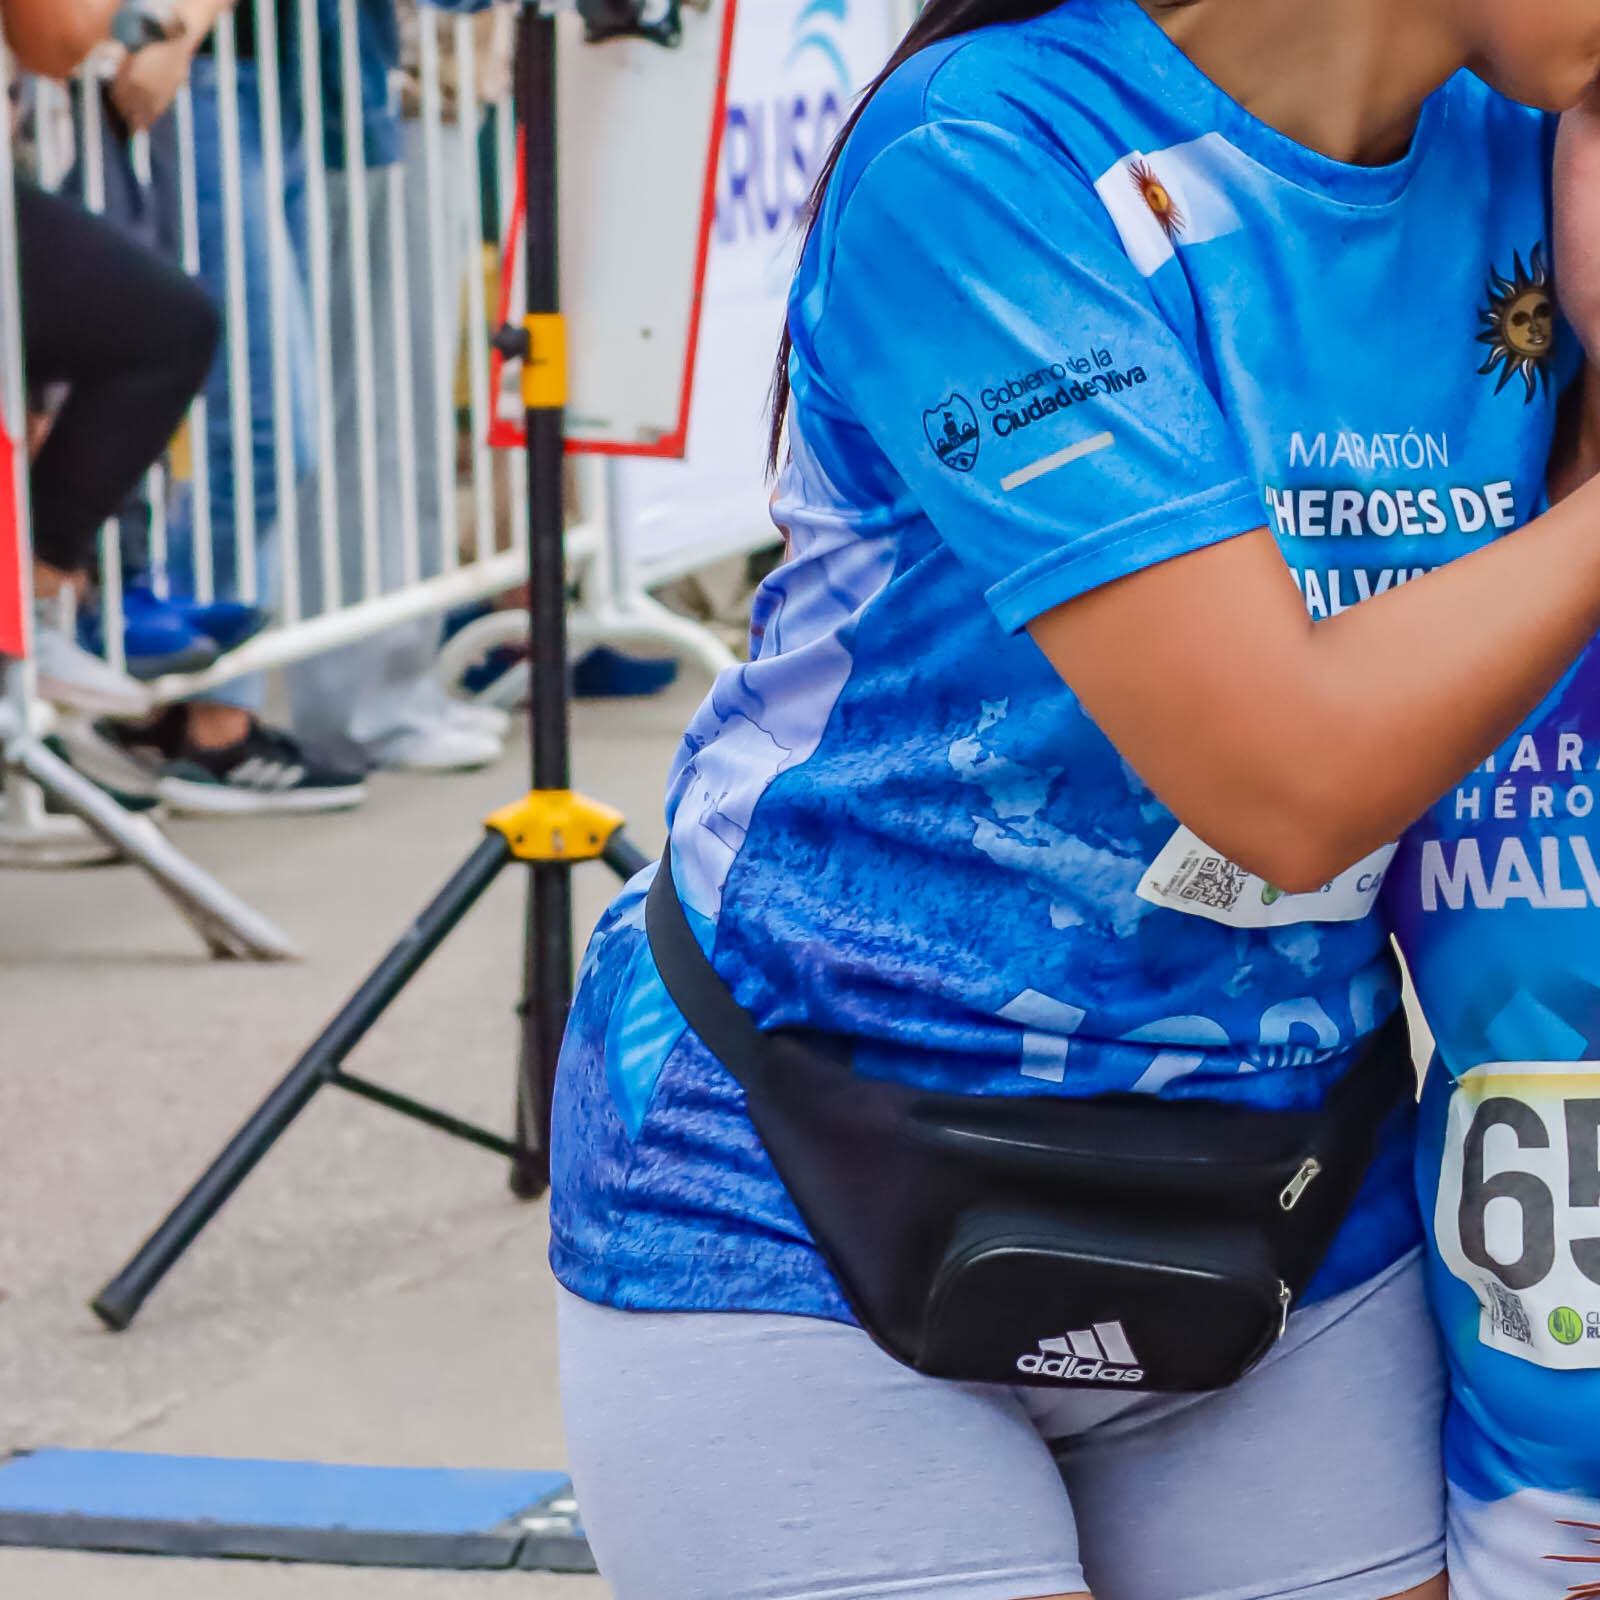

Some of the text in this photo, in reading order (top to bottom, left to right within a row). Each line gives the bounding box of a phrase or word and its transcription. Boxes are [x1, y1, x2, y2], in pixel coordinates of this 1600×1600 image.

[979, 346, 1113, 412] Gobierno de la
[1289, 426, 1449, 470] MARATÓN
[1449, 480, 1515, 533] DE
[1016, 1351, 1144, 1382] adidas
